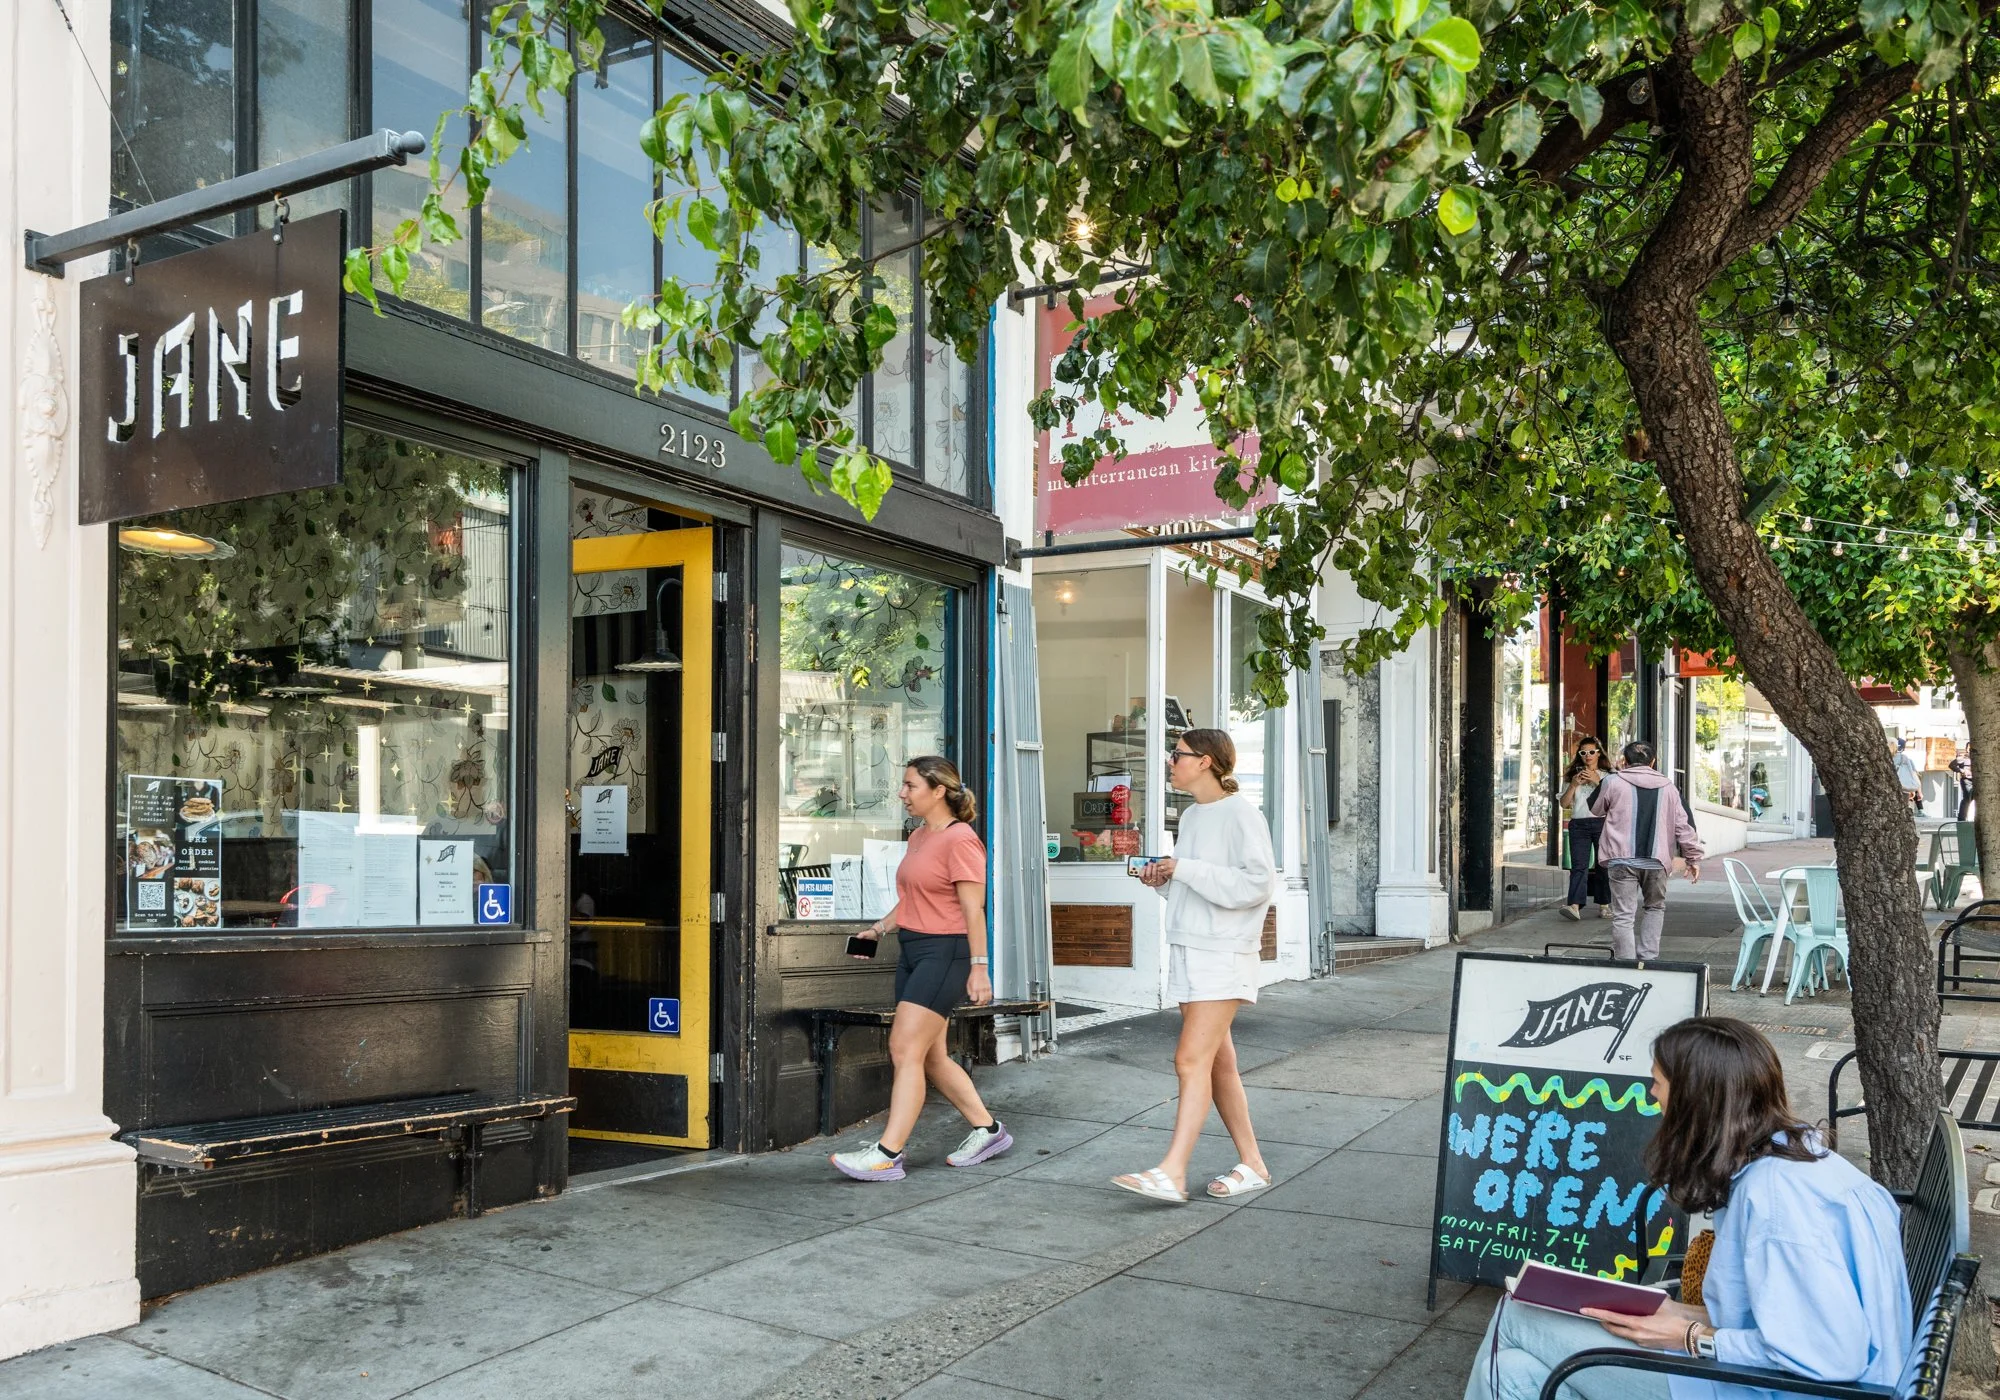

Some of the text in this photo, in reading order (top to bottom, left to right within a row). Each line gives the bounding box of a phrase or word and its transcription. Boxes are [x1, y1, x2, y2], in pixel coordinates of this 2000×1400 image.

[108, 290, 303, 442] JANE
[660, 423, 727, 468] 2123
[1047, 463, 1180, 491] meiterranean
[590, 748, 618, 775] JANE
[181, 848, 214, 856] ORDER
[805, 883, 815, 892] PETS
[815, 883, 833, 892] ALLOWED
[1524, 989, 1623, 1041] JANE
[1448, 1110, 1607, 1172] WE'RE
[1440, 1215, 1590, 1254] MON-FRI: 7-4
